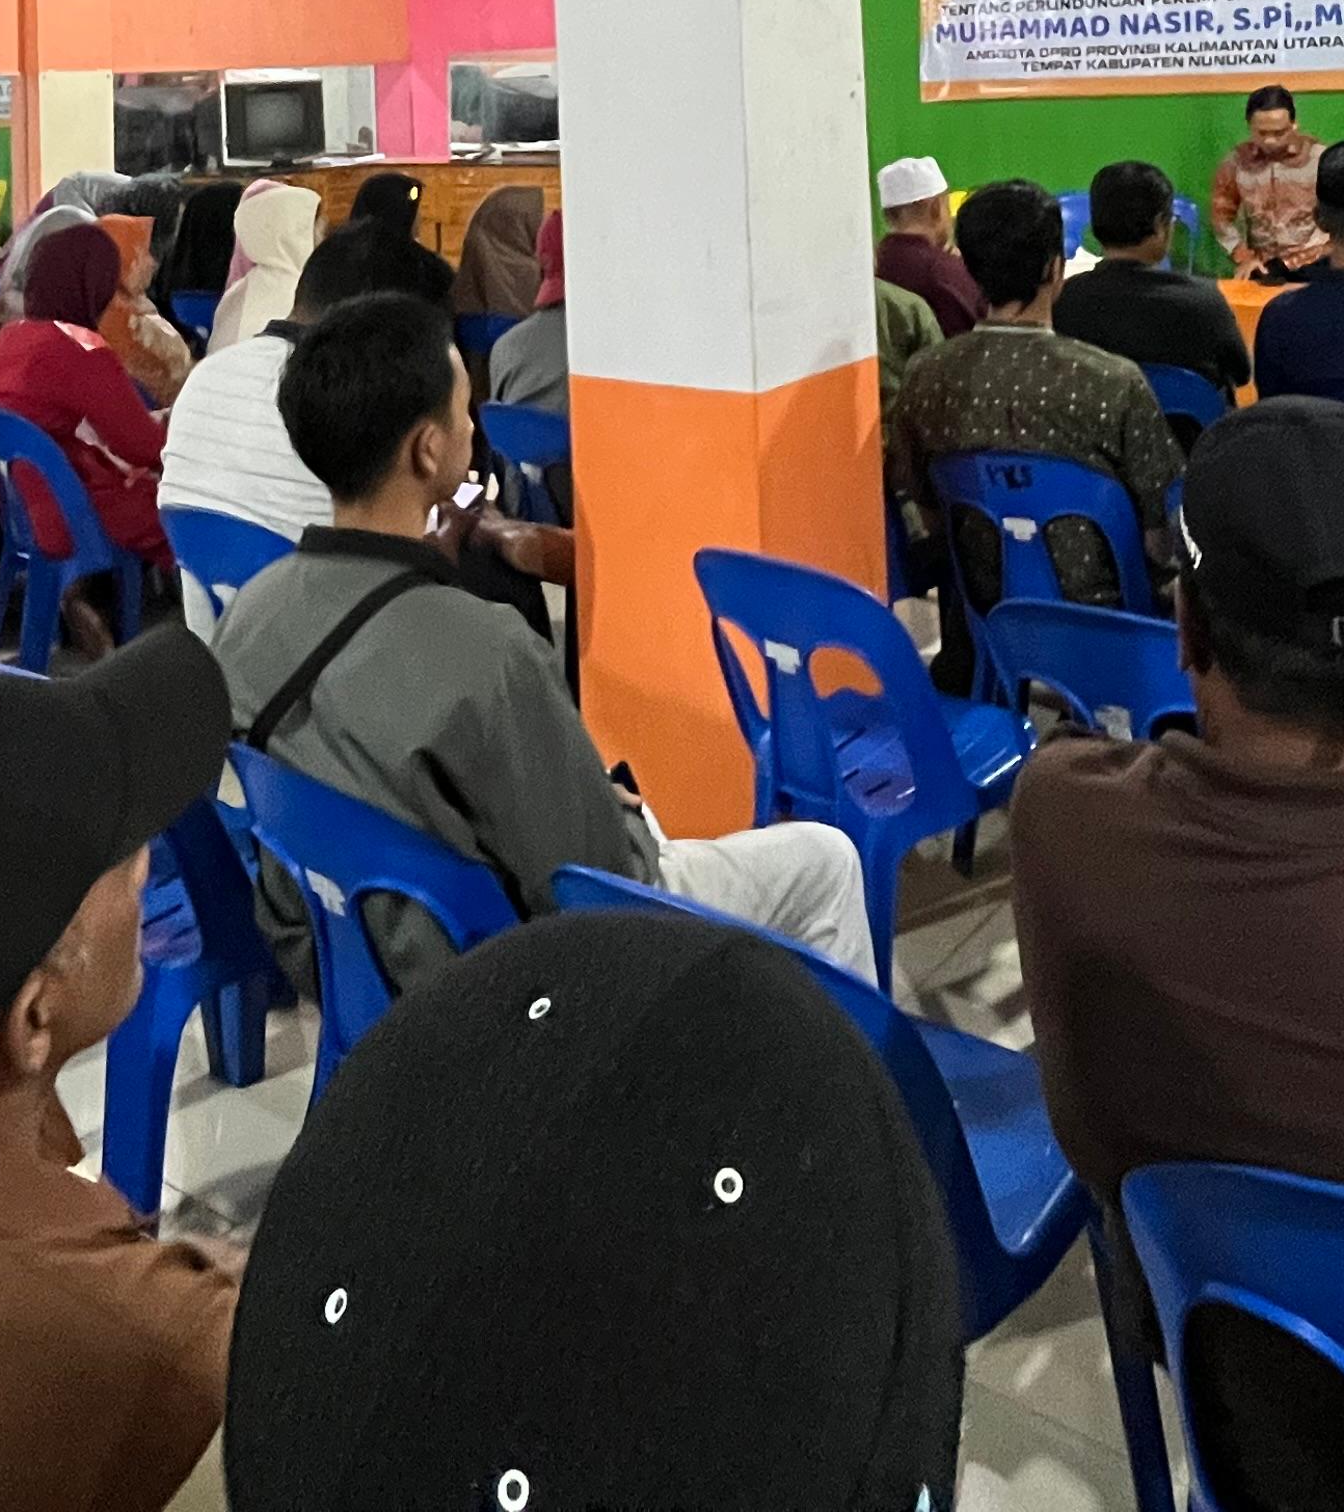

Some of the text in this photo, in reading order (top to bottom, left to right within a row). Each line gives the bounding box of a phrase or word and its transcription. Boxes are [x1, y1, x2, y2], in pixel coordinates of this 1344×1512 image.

[942, 1, 1011, 17] TENTANG
[935, 14, 1110, 44] MUHAMMAD
[1120, 9, 1224, 35] NASIR,
[966, 35, 1344, 61] ANGGOTA DPRD PROVINSI KALIMANTAN UTARA
[1022, 53, 1276, 73] TEMPAT KABUPATEN NUNUKAN
